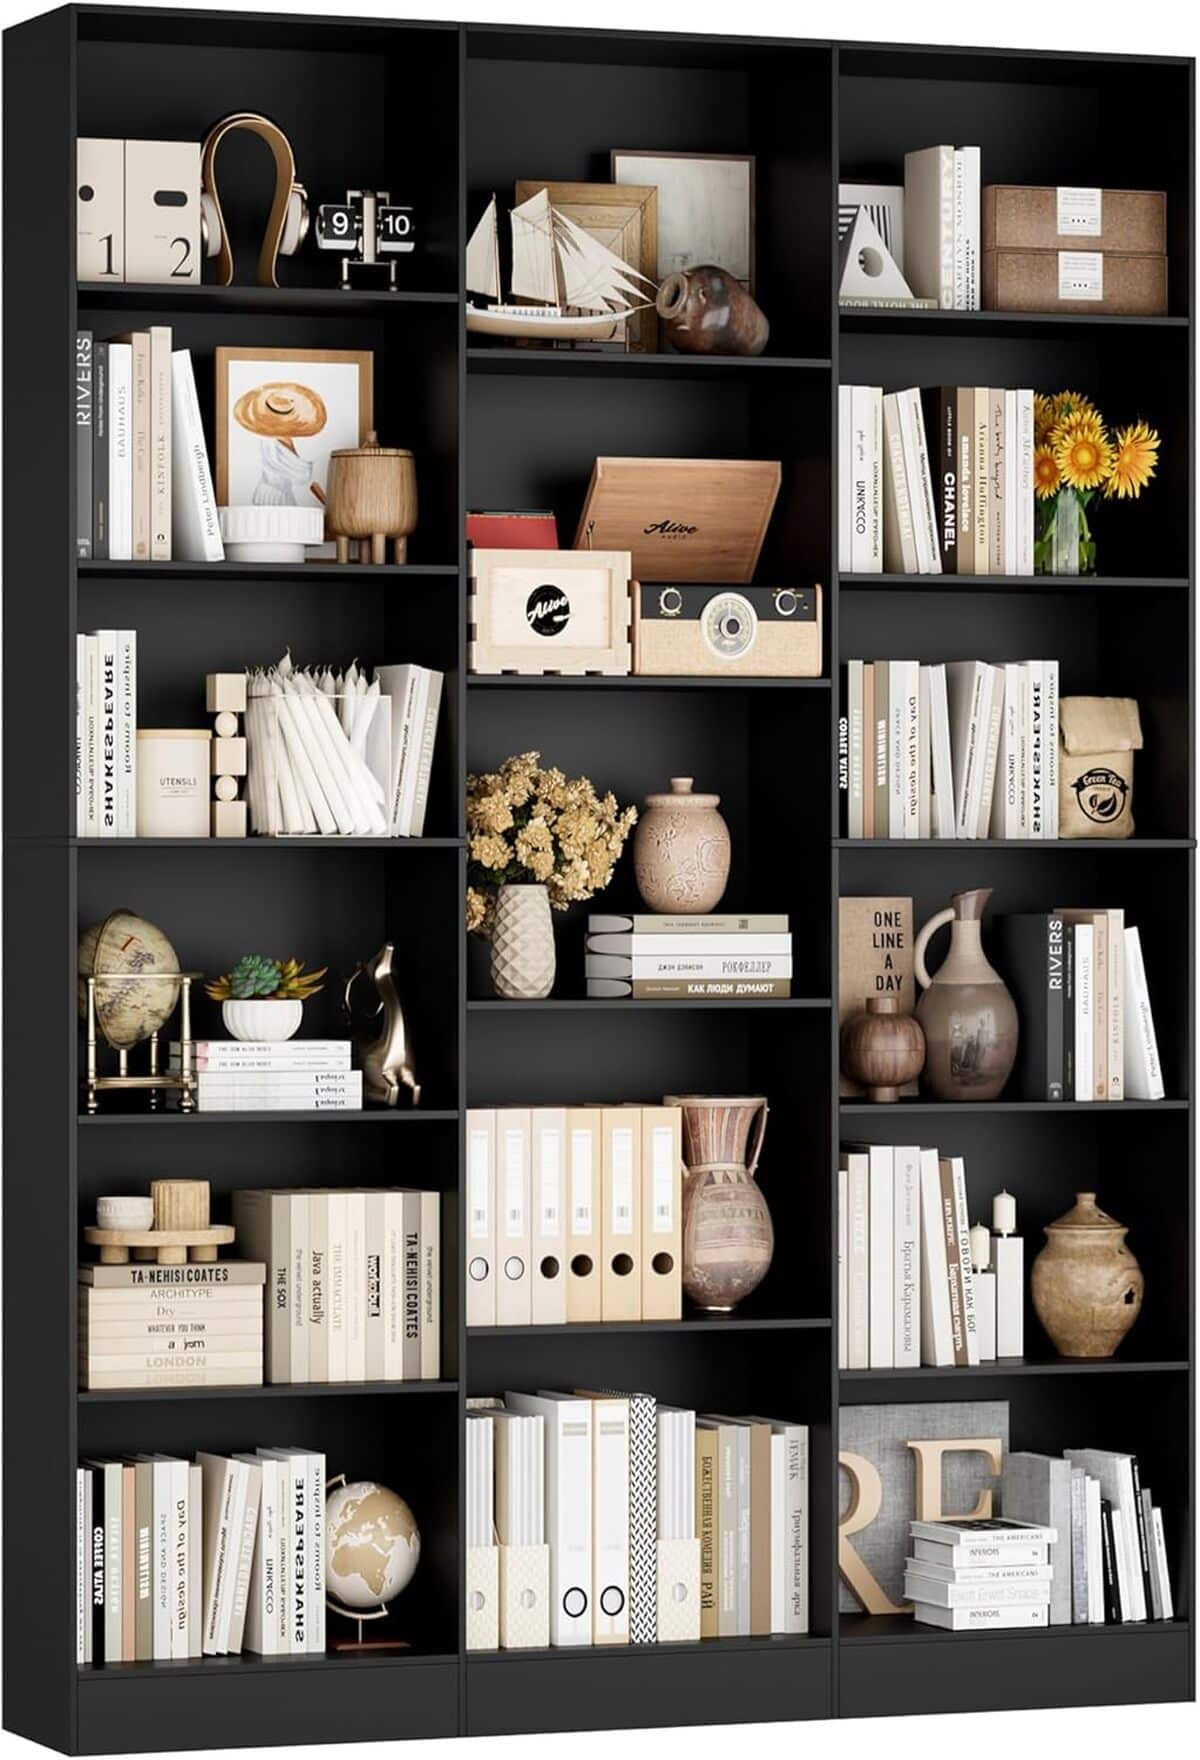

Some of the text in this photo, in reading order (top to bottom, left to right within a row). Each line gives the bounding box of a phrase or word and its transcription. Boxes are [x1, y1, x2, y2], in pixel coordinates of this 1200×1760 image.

[332, 210, 347, 235] 9
[385, 213, 410, 235] 10
[98, 233, 120, 276] 1
[170, 236, 194, 278] 2
[76, 337, 91, 425] RIVERS
[117, 385, 126, 458] BAUHAUS
[157, 434, 166, 495] KINFOLK
[192, 444, 216, 537] Peter Lindbergh
[961, 436, 971, 533] amanda lovelace
[977, 422, 987, 544] Arianna Huffington
[944, 472, 956, 551] CHANEL
[644, 520, 697, 535] Alive
[528, 596, 568, 625] Alive
[1083, 774, 1122, 788] Green Tea
[874, 911, 902, 928] ONE
[872, 932, 904, 949] LINE
[722, 961, 772, 974] РОКФЕЛЛЕР
[884, 955, 894, 970] A
[1049, 920, 1062, 990] RIVERS
[688, 984, 706, 994] КАК
[706, 984, 734, 994] ЛЮДИ
[736, 984, 775, 994] ДУМАЮТ
[876, 975, 903, 991] DAY
[959, 1230, 972, 1284] ГОВОРИ
[130, 1268, 229, 1284] TA-NEHISI COATES
[277, 1268, 286, 1309] THE SOX
[310, 1250, 324, 1325] Java actually
[406, 1232, 418, 1339] TA-NEHISI COATES
[150, 1288, 214, 1299] ARCHITYPE
[900, 1240, 915, 1353] Братья Карамазовы
[966, 1288, 974, 1310] КАК
[156, 1306, 175, 1318] Dry
[967, 1314, 976, 1334] БОГ
[168, 1340, 176, 1350] a
[146, 1356, 206, 1368] LONDON
[702, 1456, 713, 1574] БОЖЕСТВЕННАЯ КОМЕДИЯ
[792, 1508, 803, 1616] Триумфальная арка
[702, 1582, 716, 1609] РАЙ
